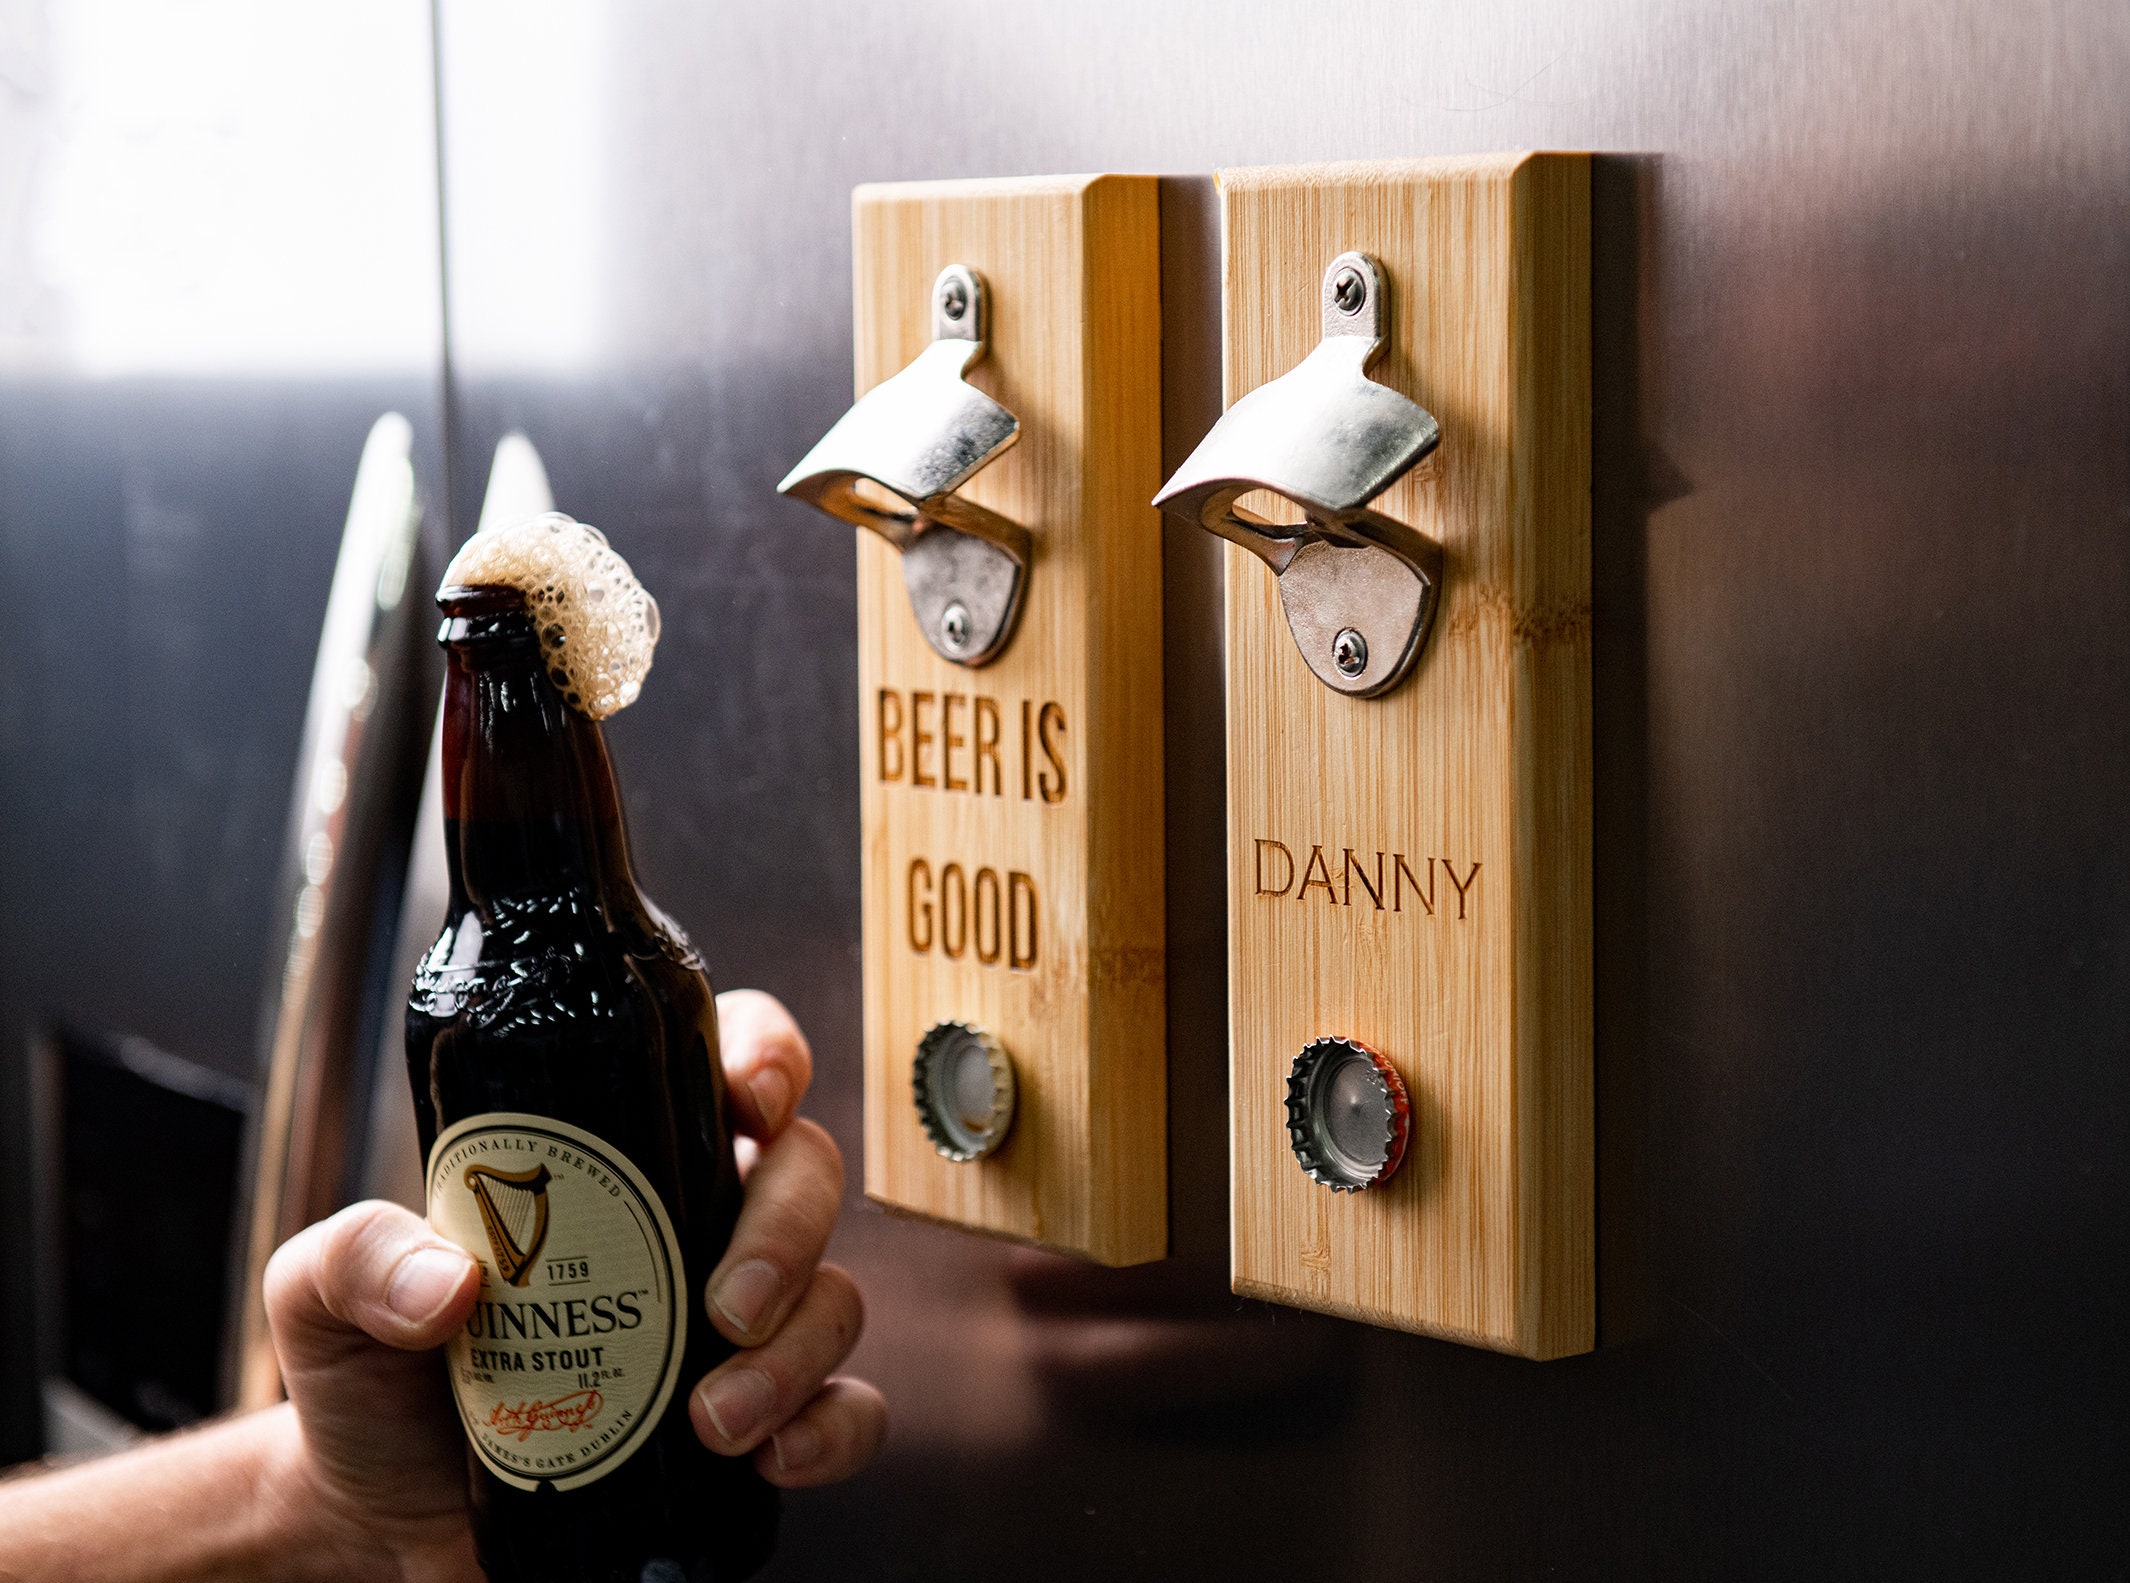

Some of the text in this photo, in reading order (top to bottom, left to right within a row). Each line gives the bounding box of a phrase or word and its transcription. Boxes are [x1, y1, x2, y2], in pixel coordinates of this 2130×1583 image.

[879, 687, 1067, 806] BEER IS
[1254, 838, 1483, 920] DANNY
[908, 857, 1040, 974] GOOD
[547, 1145, 621, 1198] BREWED
[547, 1261, 589, 1281] 1759
[466, 1290, 643, 1340] UINNESS
[471, 1346, 604, 1372] EXTRA STOUT
[580, 1410, 632, 1457] DUBLIN
